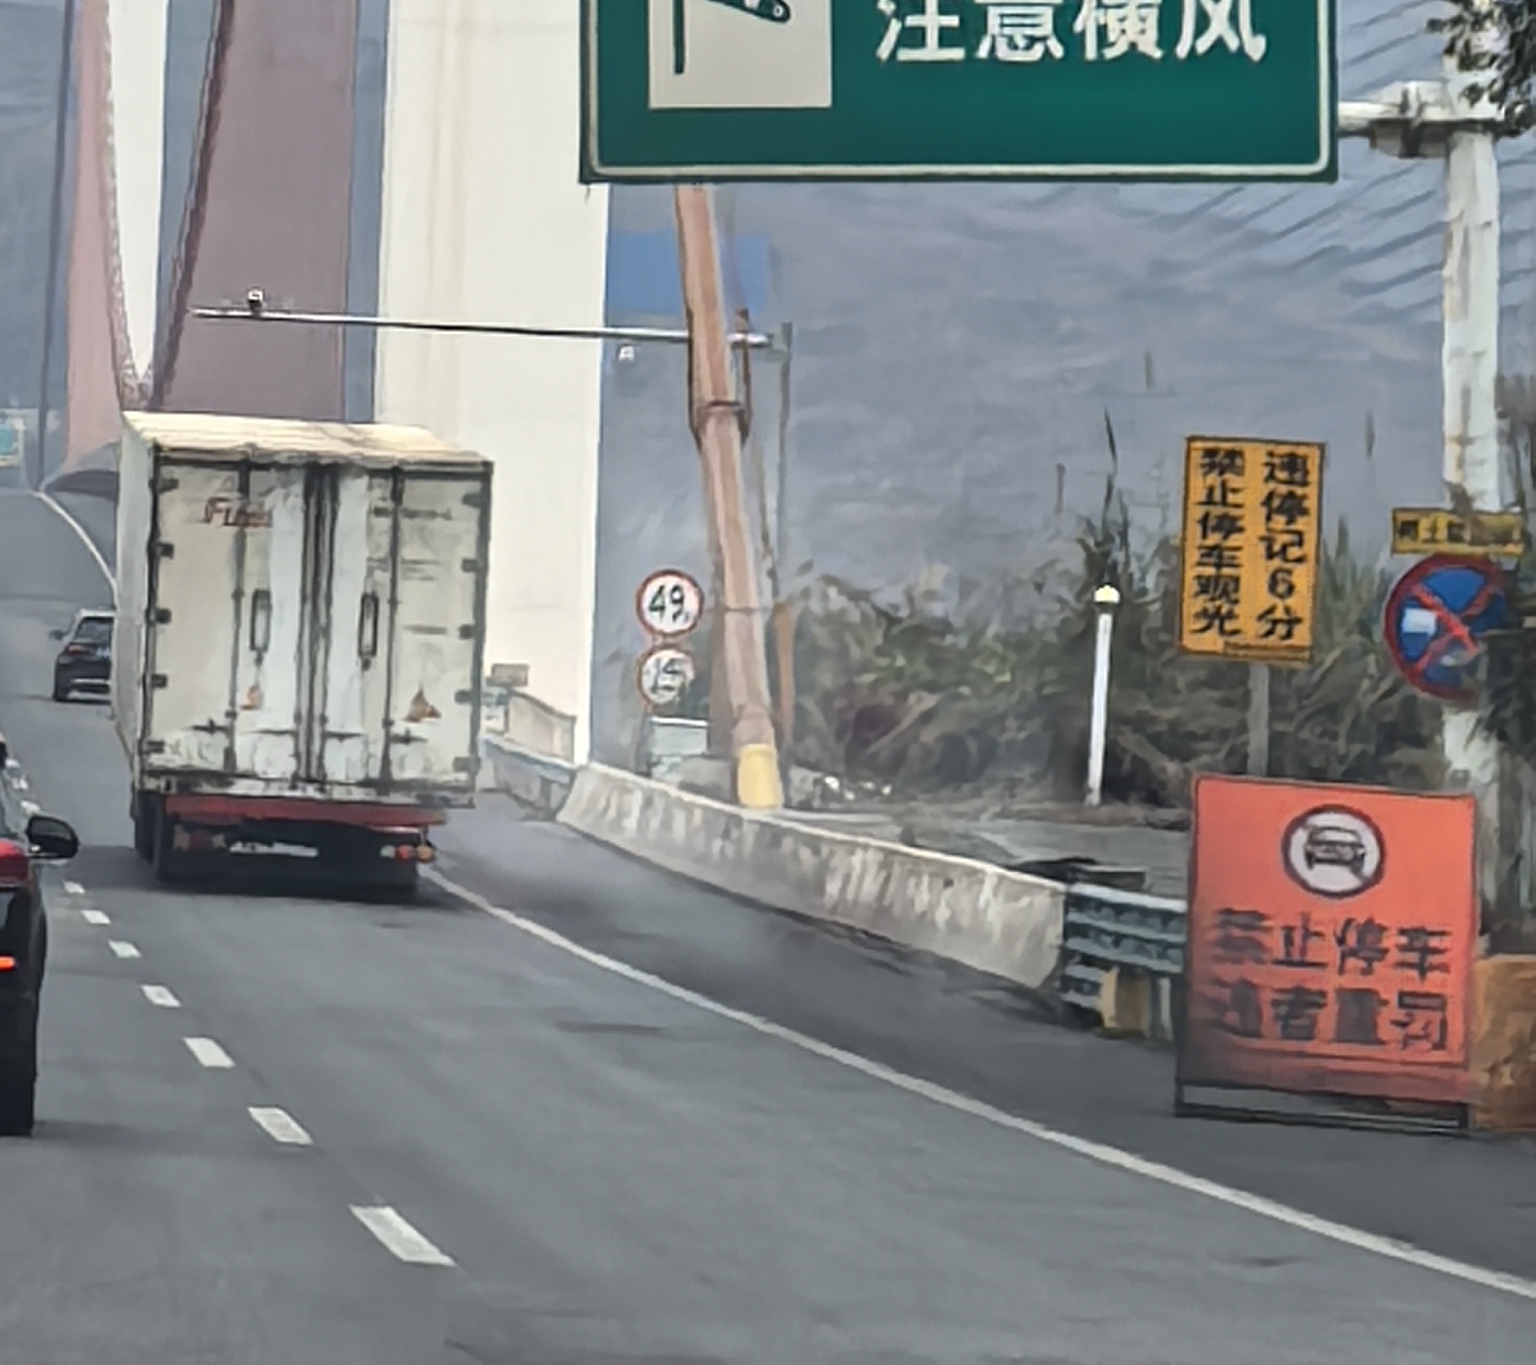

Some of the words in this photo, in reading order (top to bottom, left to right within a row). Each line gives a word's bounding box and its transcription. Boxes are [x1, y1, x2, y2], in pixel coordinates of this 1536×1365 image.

[1189, 448, 1245, 637] 禁止停车观光
[1256, 451, 1310, 641] 违停记6分
